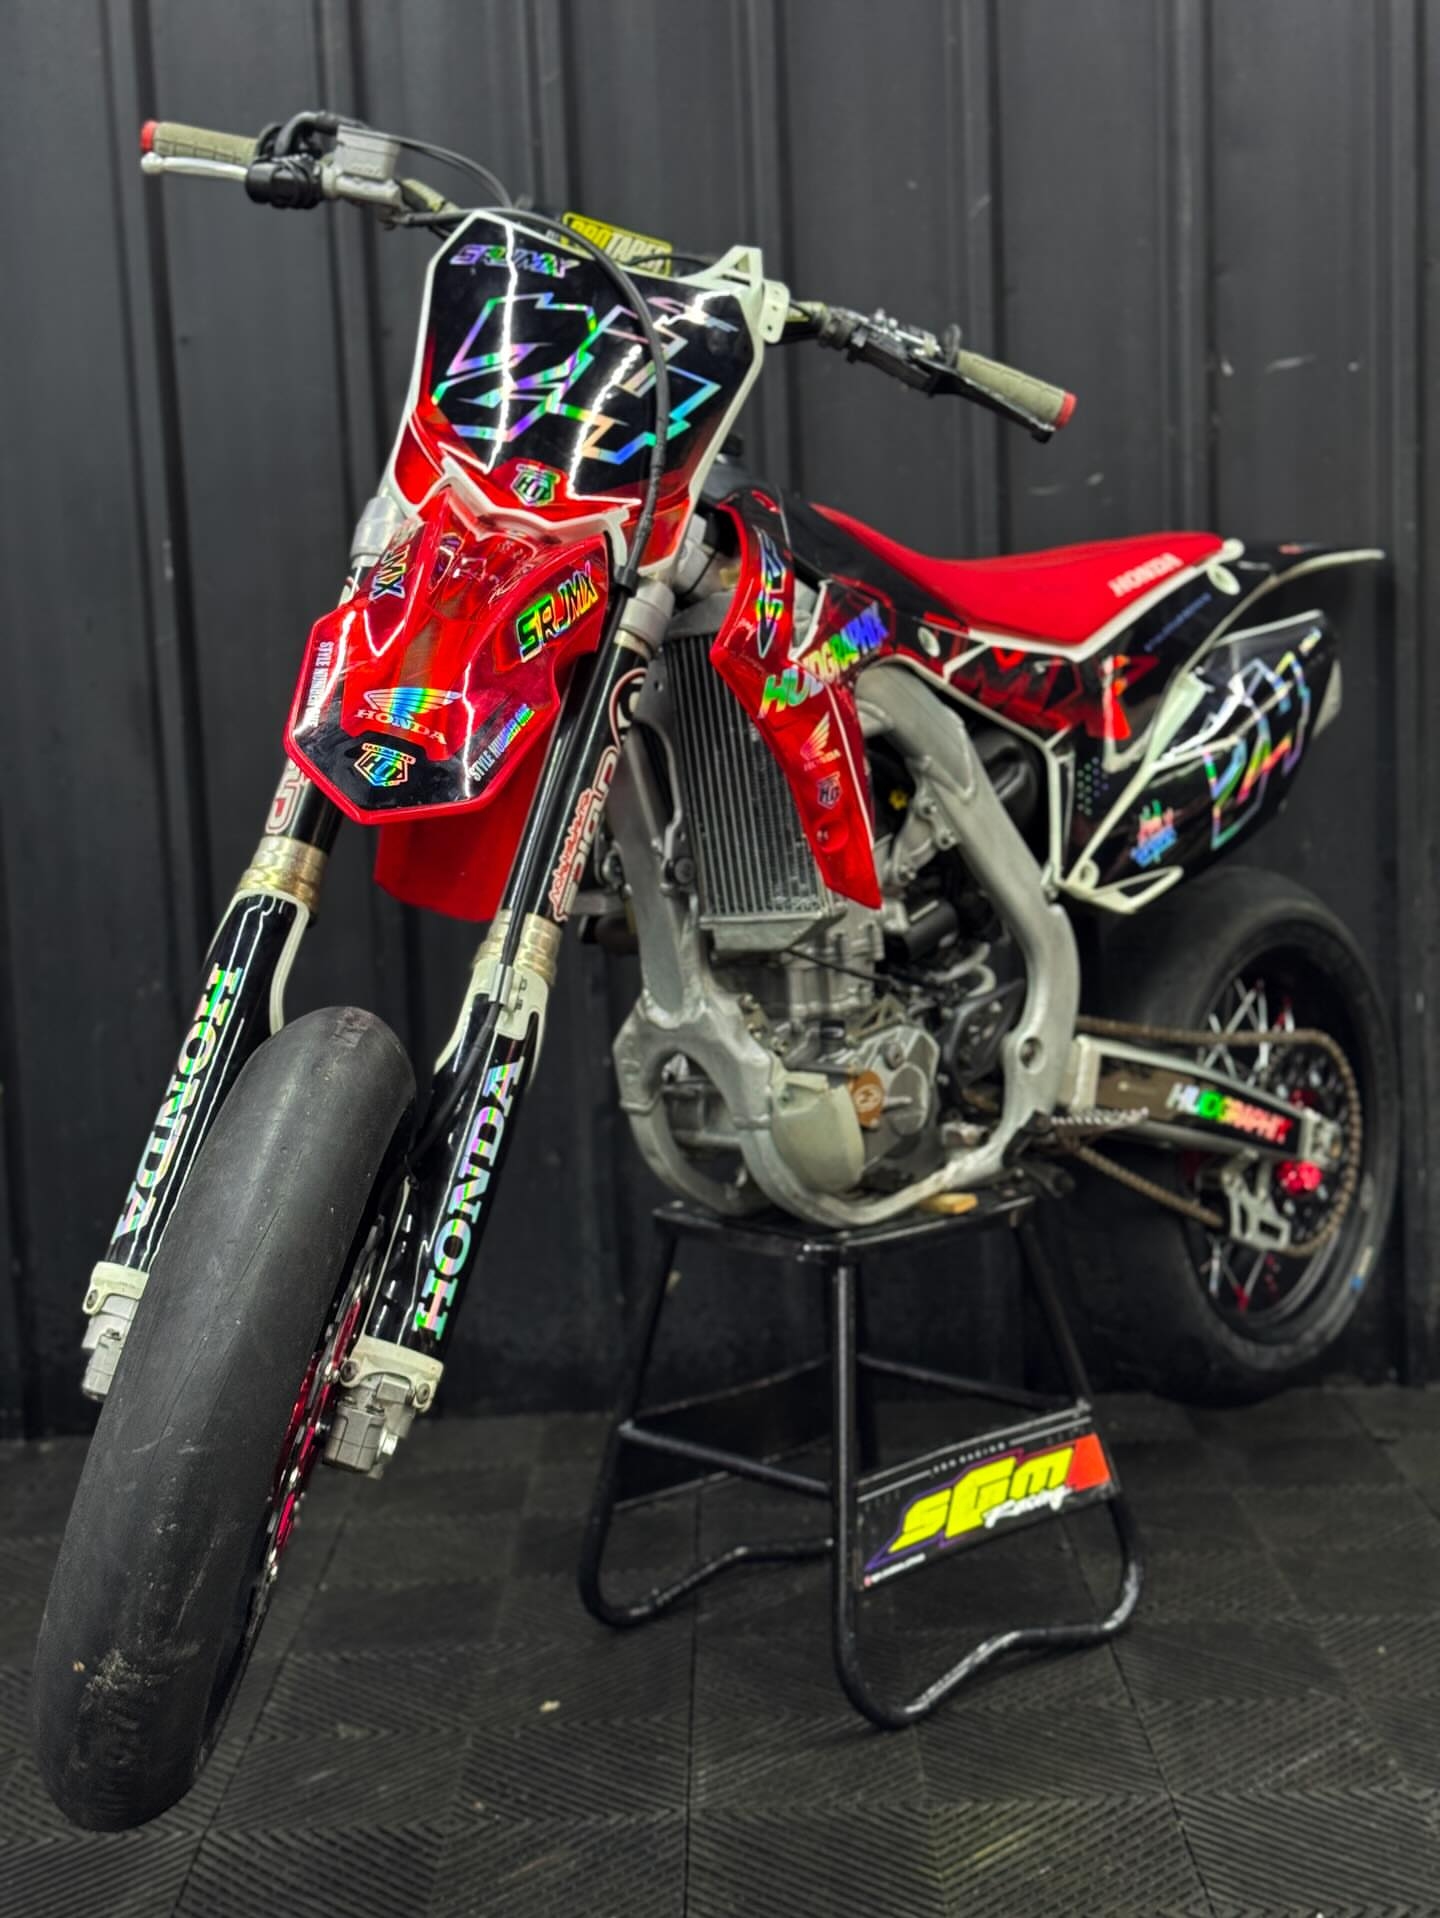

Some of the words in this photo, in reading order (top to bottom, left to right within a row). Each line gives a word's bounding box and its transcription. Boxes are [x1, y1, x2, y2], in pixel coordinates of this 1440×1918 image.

[1108, 552, 1184, 598] HONDA
[317, 640, 334, 672] STYLE
[354, 708, 448, 745] HONDA
[469, 749, 495, 782] STYLE
[111, 962, 243, 1245] HONDA
[411, 1055, 526, 1341] HONDA
